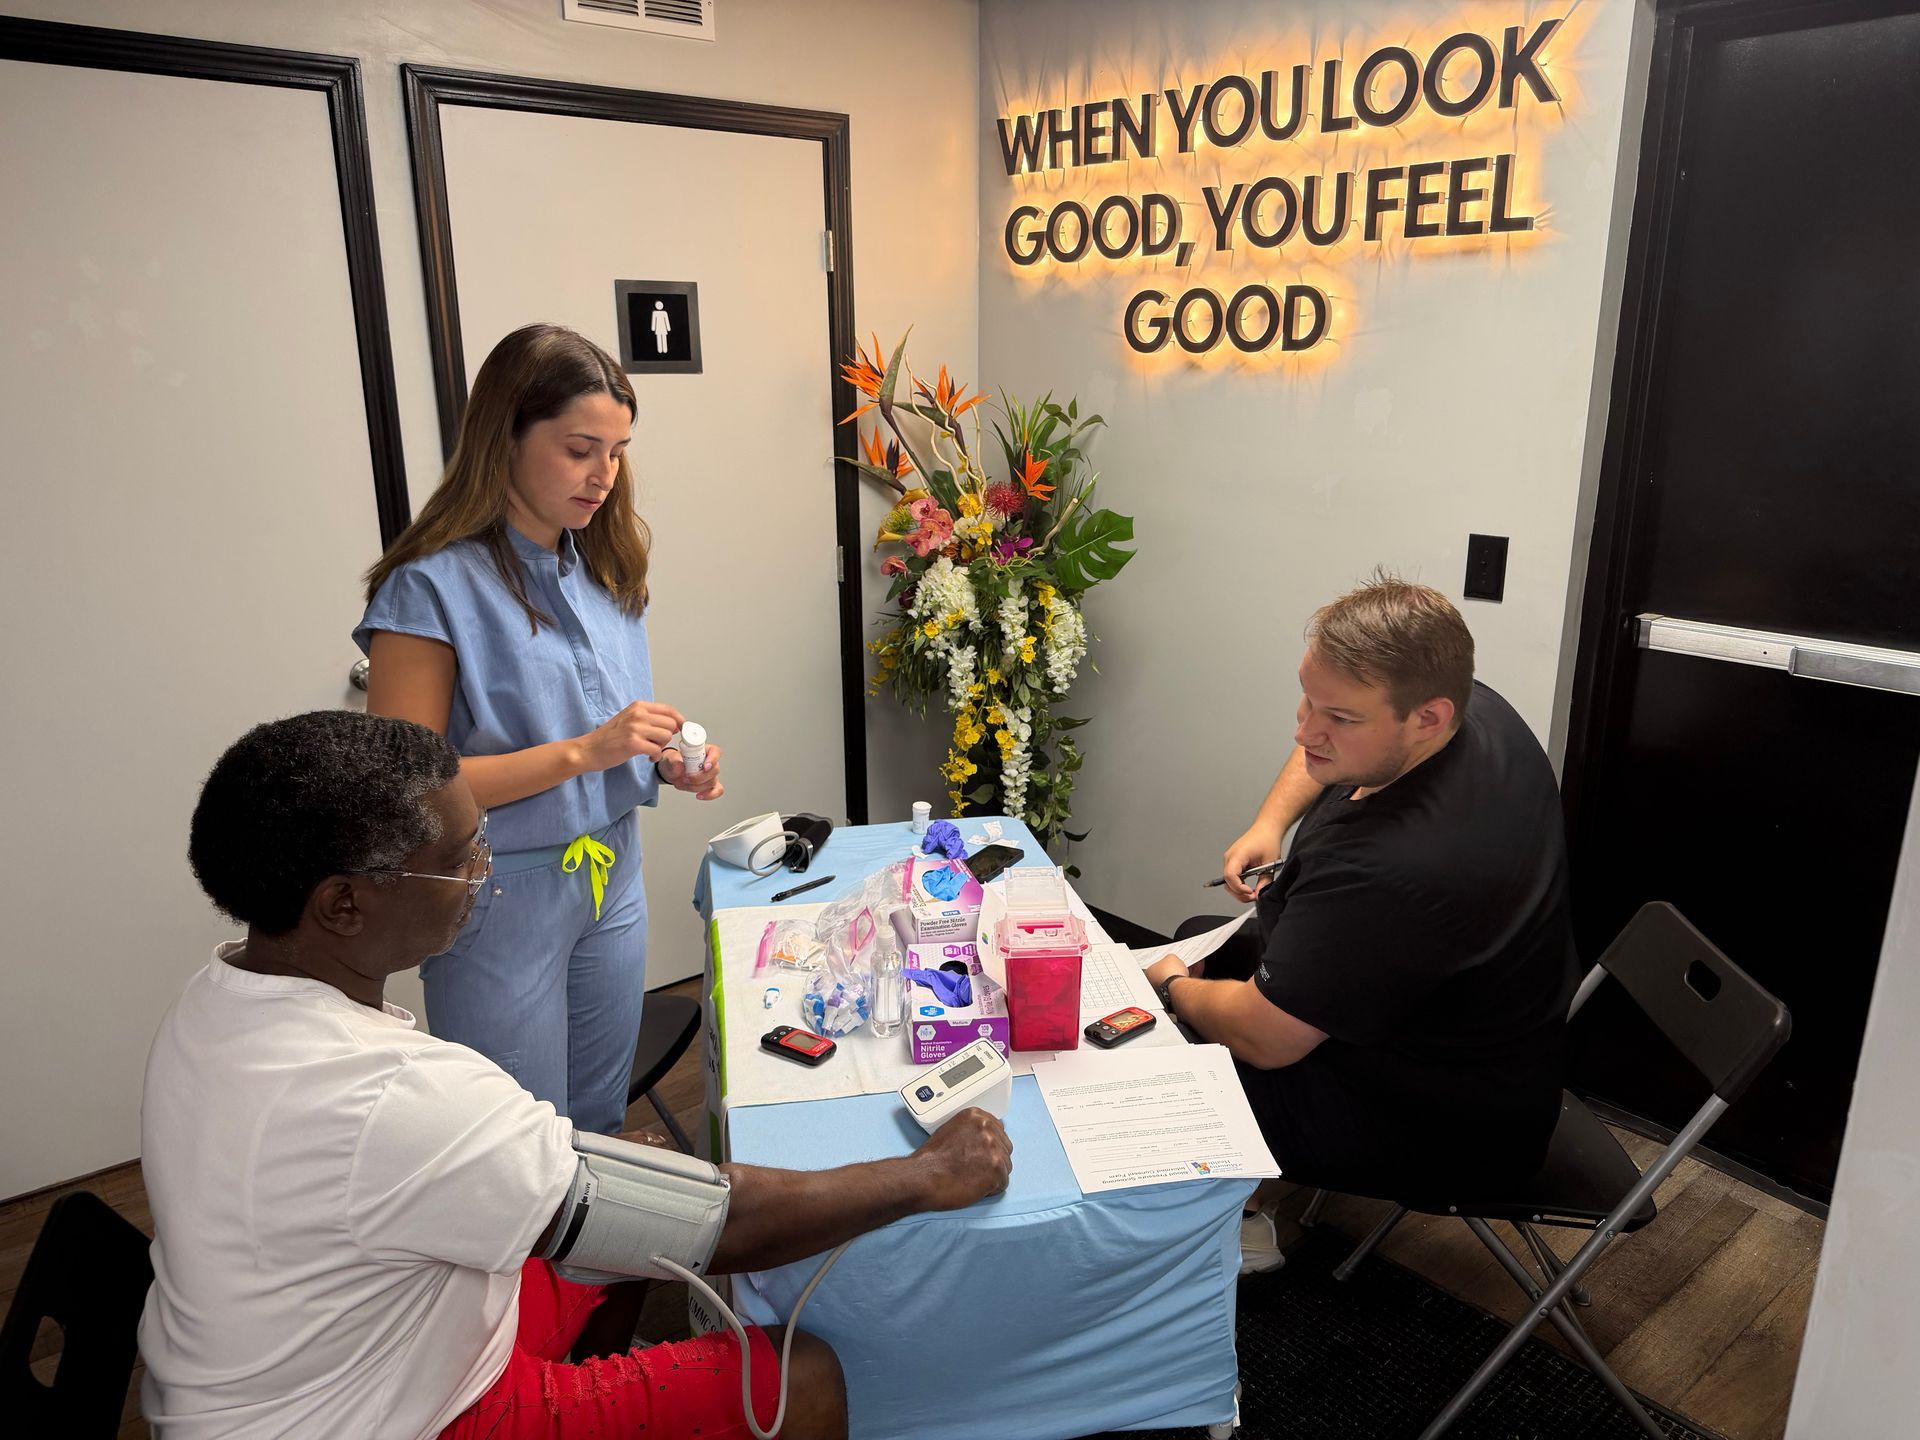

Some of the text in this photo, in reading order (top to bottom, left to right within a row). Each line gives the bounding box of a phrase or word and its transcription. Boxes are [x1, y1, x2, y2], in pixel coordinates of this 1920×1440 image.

[997, 19, 1565, 176] WHEN YOU LOOK
[1005, 153, 1534, 267] GOOD, YOU FEEL
[1124, 284, 1332, 355] GOOD
[920, 1044, 946, 1052] Nitrile
[1102, 1176, 1137, 1184] Screening
[1127, 1169, 1155, 1177] Consent
